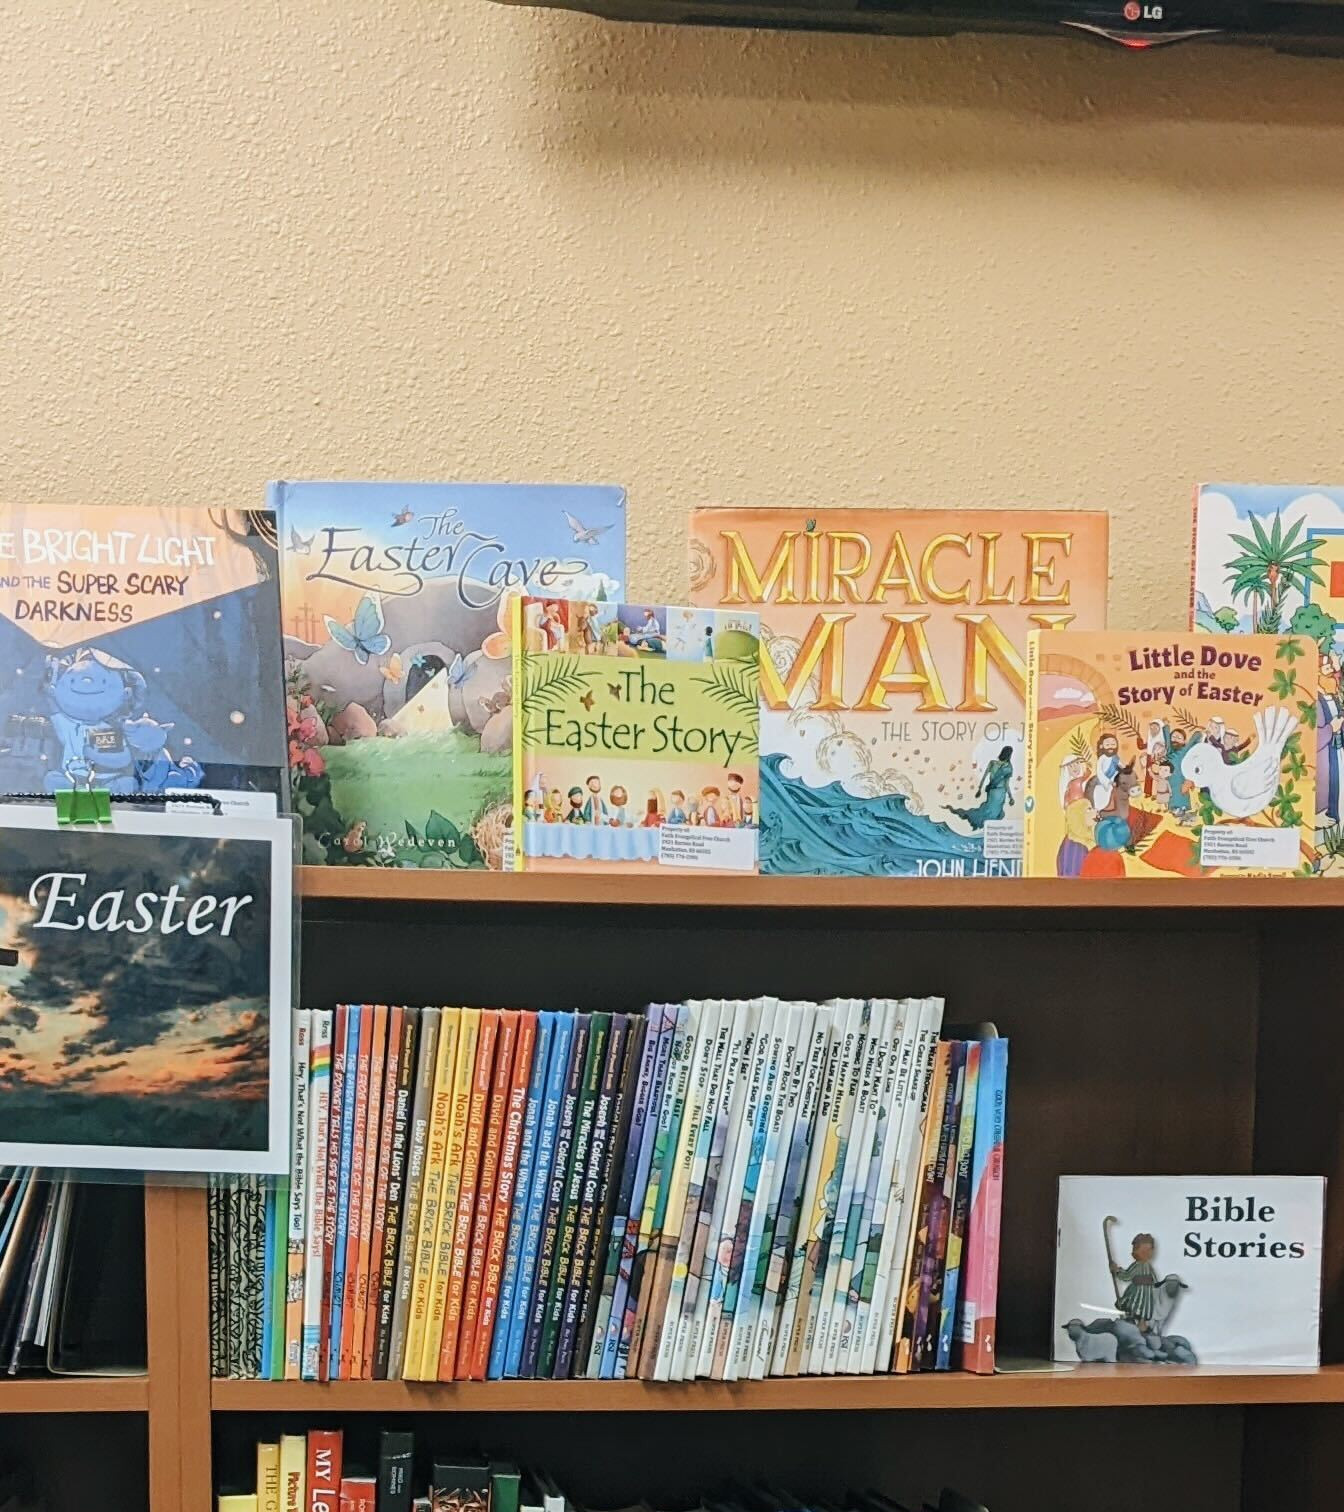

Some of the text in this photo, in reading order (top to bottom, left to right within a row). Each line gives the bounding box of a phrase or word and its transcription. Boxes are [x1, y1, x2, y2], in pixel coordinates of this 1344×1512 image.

[1143, 6, 1163, 20] LG
[417, 508, 465, 540] The
[22, 528, 136, 565] BRIGHT
[136, 534, 216, 566] LIGHT
[306, 527, 588, 609] Easter Cave
[719, 530, 1074, 605] MIRACLE
[23, 575, 51, 589] THE
[57, 570, 119, 595] SUPER
[124, 572, 190, 596] SCARY
[15, 599, 133, 622] DARKNESS
[760, 612, 1076, 712] MAN
[1129, 644, 1263, 672] Little Dove
[618, 665, 675, 705] The
[1174, 669, 1216, 680] and the
[1118, 682, 1264, 707] Story of Easter
[546, 709, 742, 768] Easter Story
[881, 721, 912, 741] THE
[921, 720, 978, 742] STORY
[983, 721, 1010, 741] OF
[915, 858, 965, 877] JOHN
[27, 871, 254, 937] Easter
[1184, 1196, 1276, 1224] Bible
[1182, 1231, 1306, 1261] Stories
[315, 1449, 333, 1482] MY
